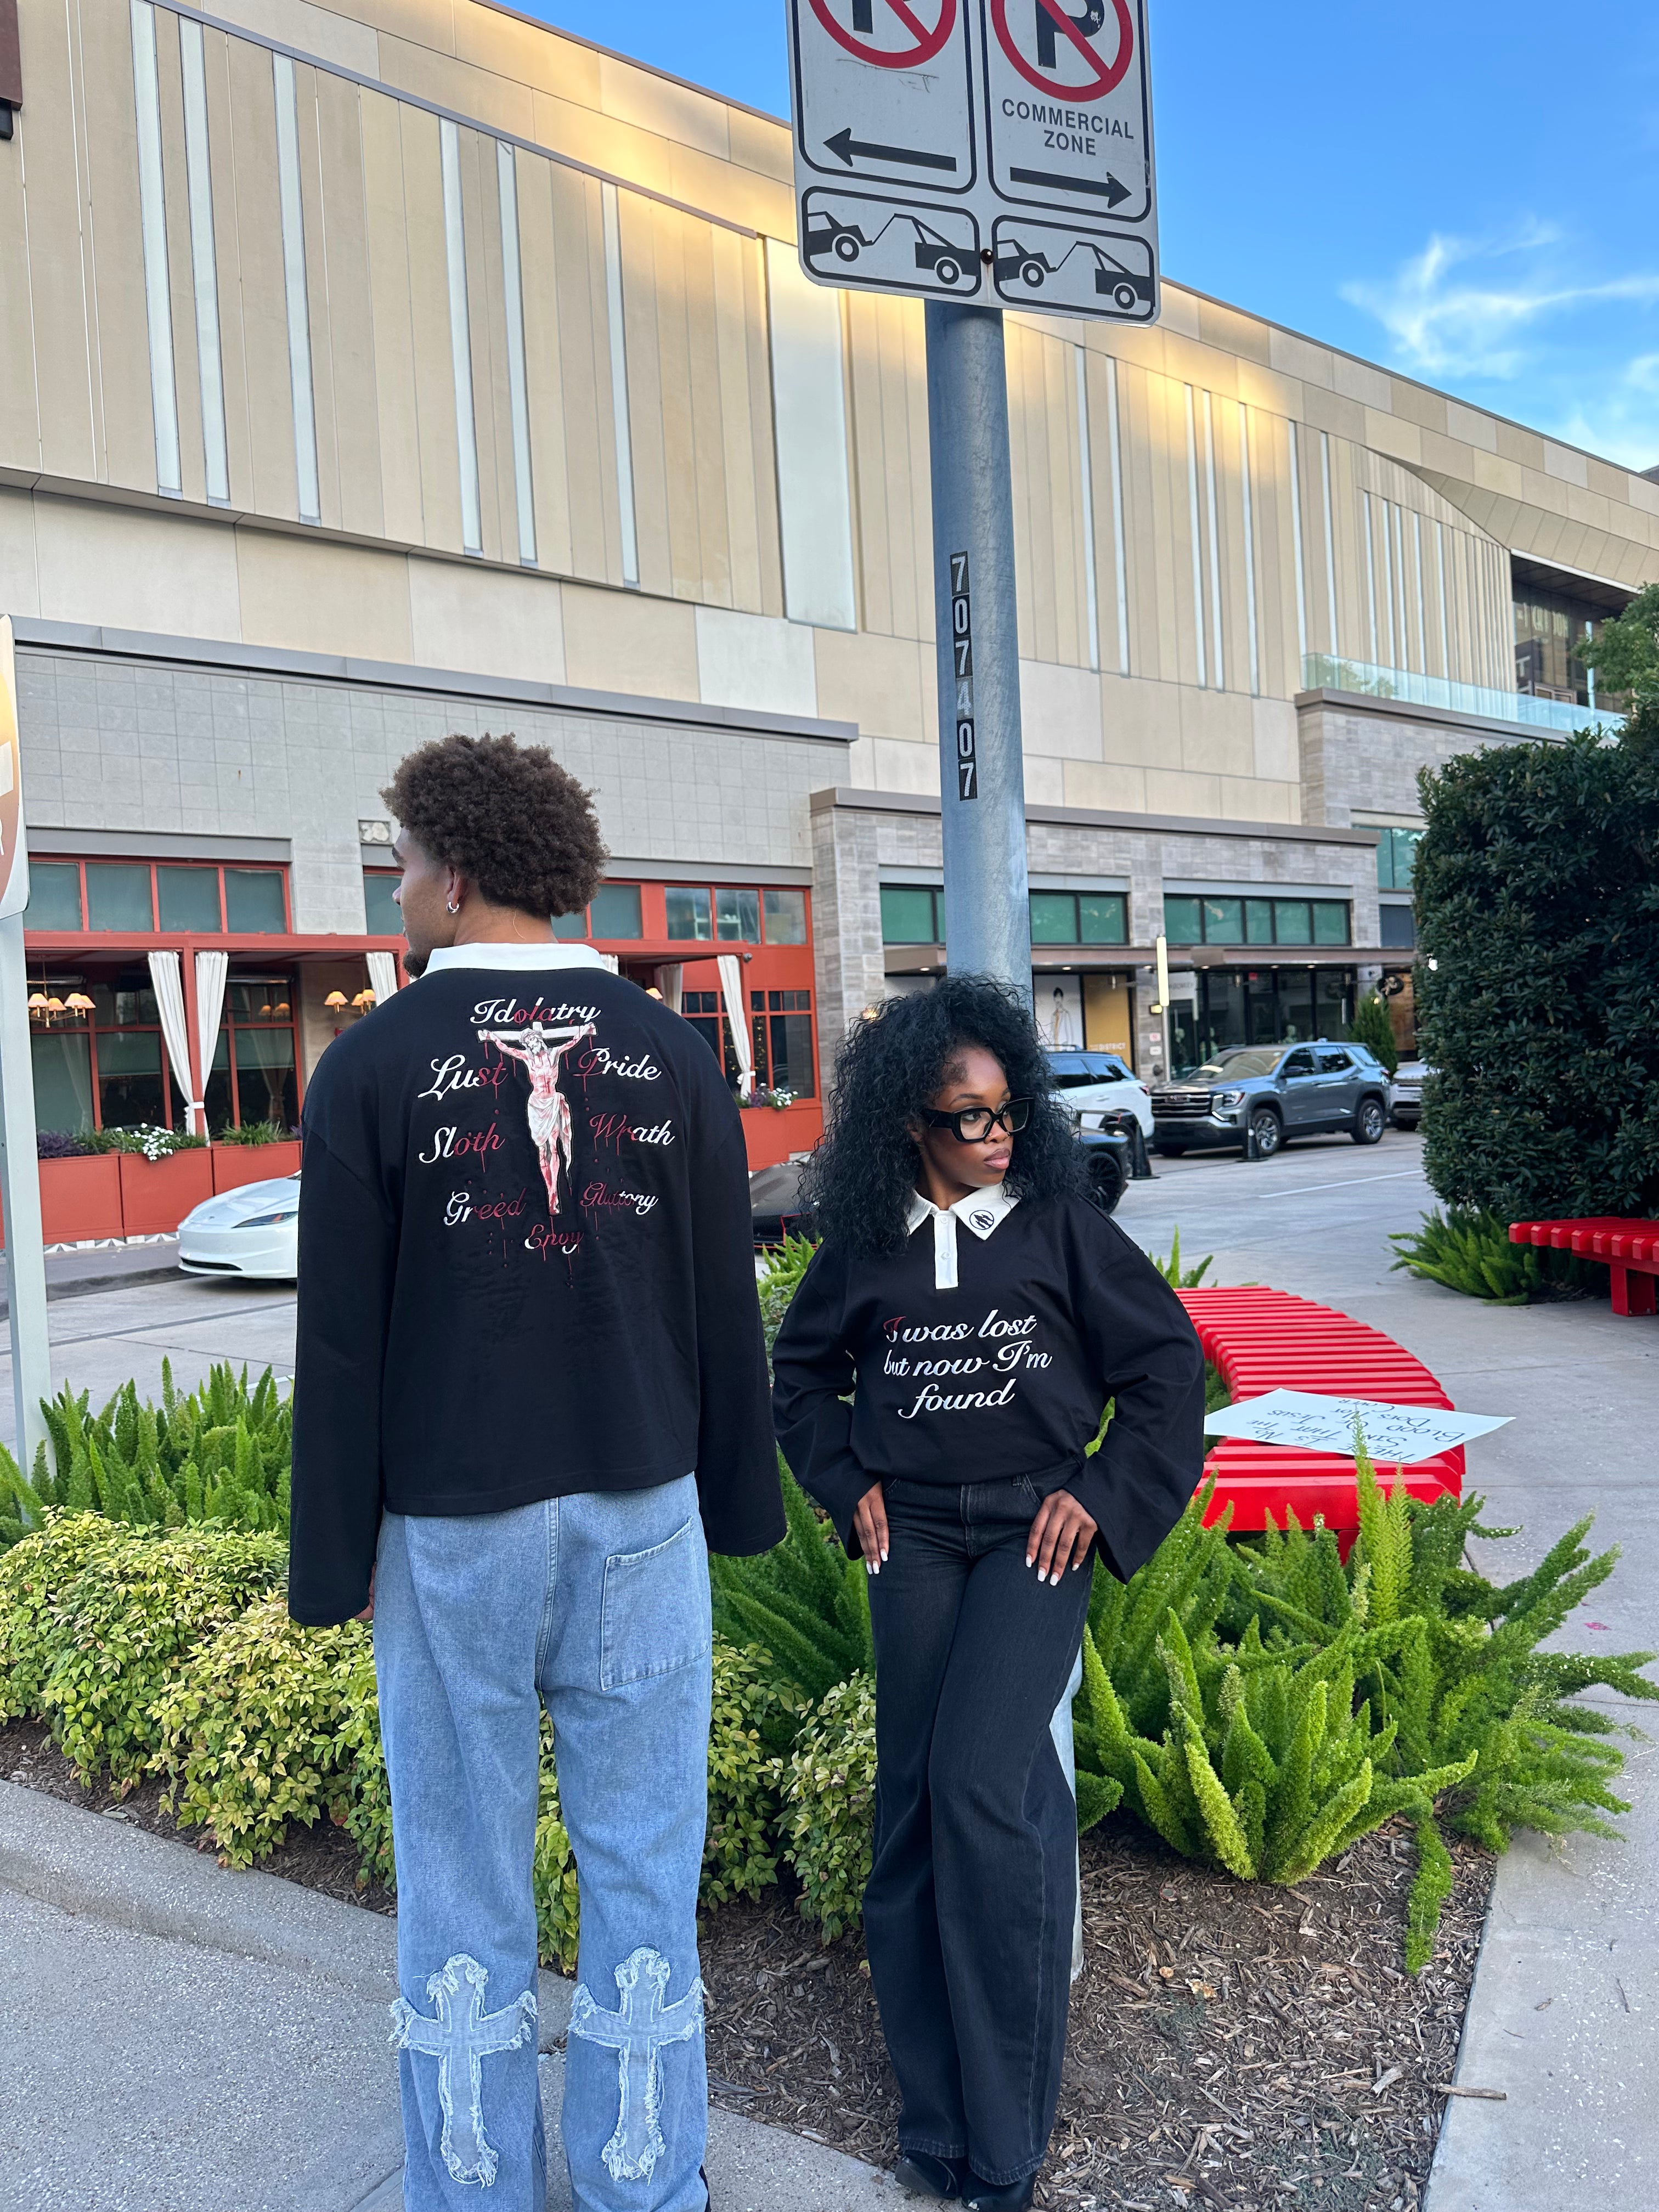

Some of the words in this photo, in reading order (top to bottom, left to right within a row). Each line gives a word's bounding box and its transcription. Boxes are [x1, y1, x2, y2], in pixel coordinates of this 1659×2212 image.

[1002, 99, 1134, 139] COMMERCIAL
[1044, 129, 1096, 156] ZONE
[951, 555, 974, 797] 707407
[470, 997, 601, 1024] Idolatry
[417, 1054, 509, 1101] Lust
[573, 1047, 662, 1080] Pride
[419, 1122, 505, 1163] Sloth
[590, 1113, 675, 1146] Wrath
[443, 1187, 527, 1226] Greed
[580, 1181, 658, 1215] Gluttony
[524, 1224, 584, 1254] Envy
[883, 1316, 906, 1343] I
[902, 1323, 974, 1343] was
[978, 1309, 1038, 1339] lost
[883, 1349, 911, 1376] but
[912, 1357, 990, 1377] now
[992, 1340, 1053, 1372] I'm
[898, 1378, 1017, 1419] found
[1338, 1399, 1395, 1412] COVER
[1267, 1409, 1325, 1424] JESUS
[1290, 1426, 1341, 1440] THAT
[1378, 1413, 1431, 1426] DOES
[1386, 1425, 1465, 1442] BLOOD
[1338, 1442, 1415, 1462] THEE
